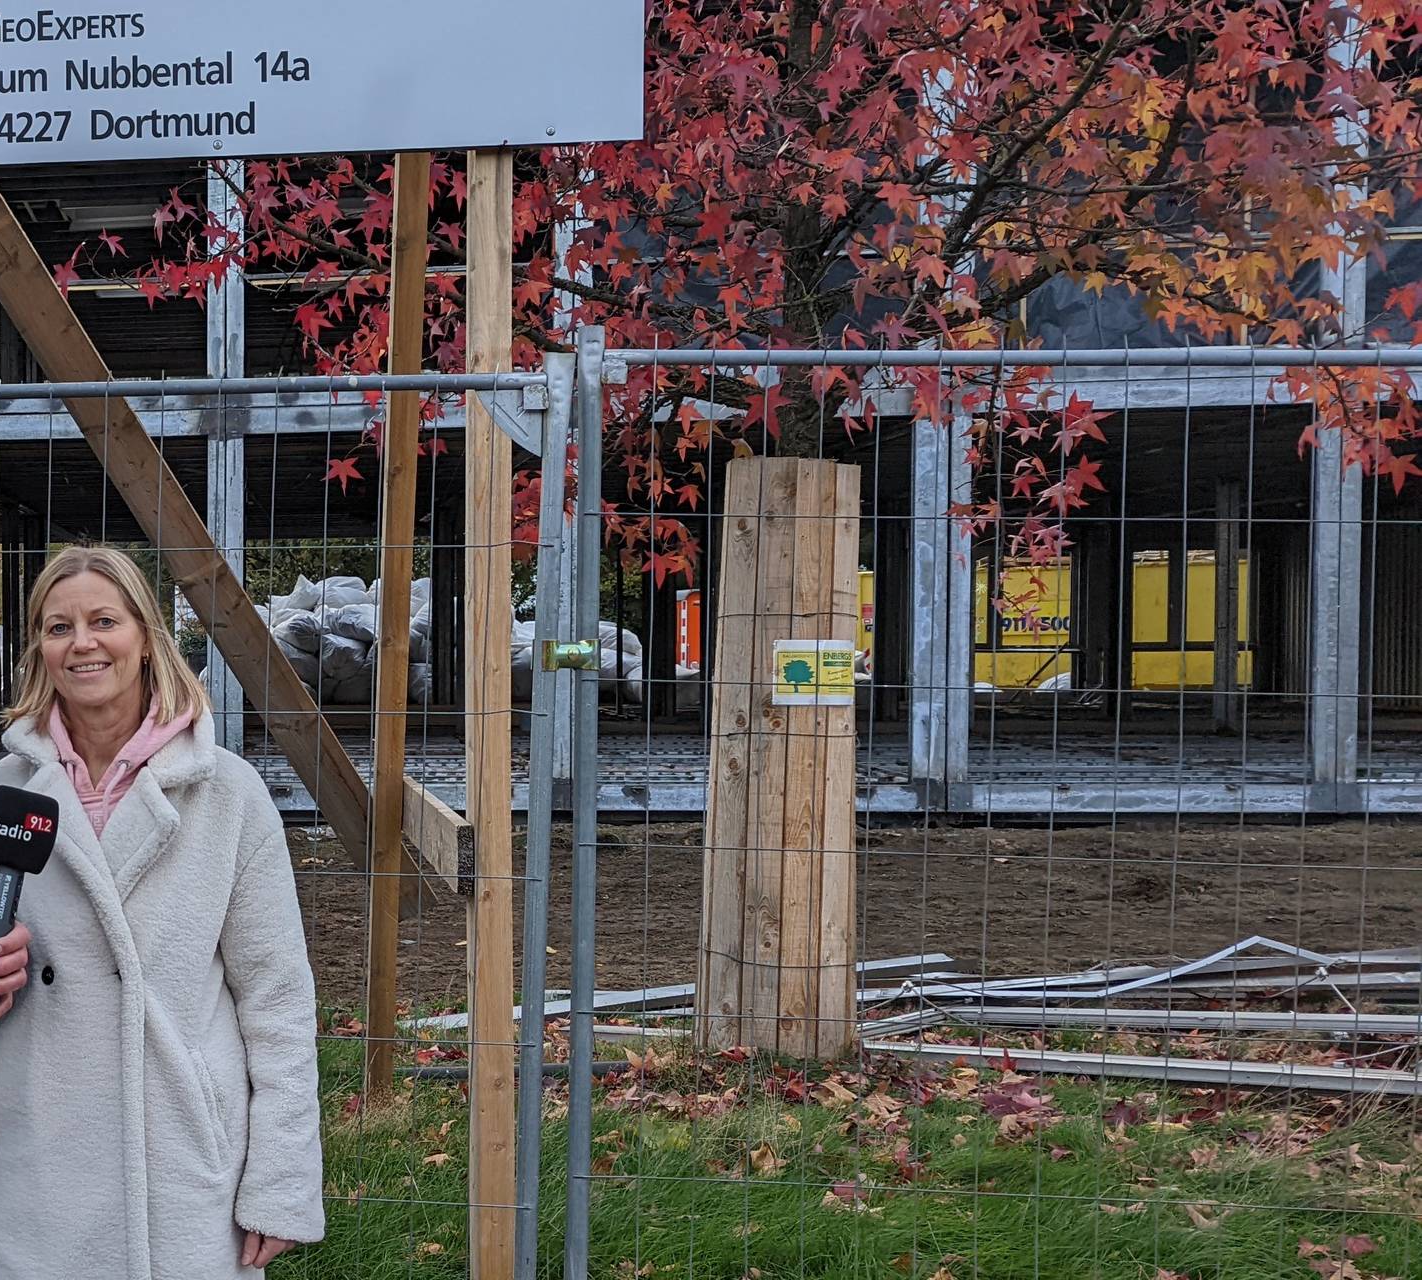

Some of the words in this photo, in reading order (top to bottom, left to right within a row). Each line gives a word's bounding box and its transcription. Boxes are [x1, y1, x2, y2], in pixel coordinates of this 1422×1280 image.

[65, 51, 232, 91] Nubbental
[254, 51, 310, 82] 14a
[90, 101, 256, 140] Dortmund
[30, 815, 53, 833] 91.2
